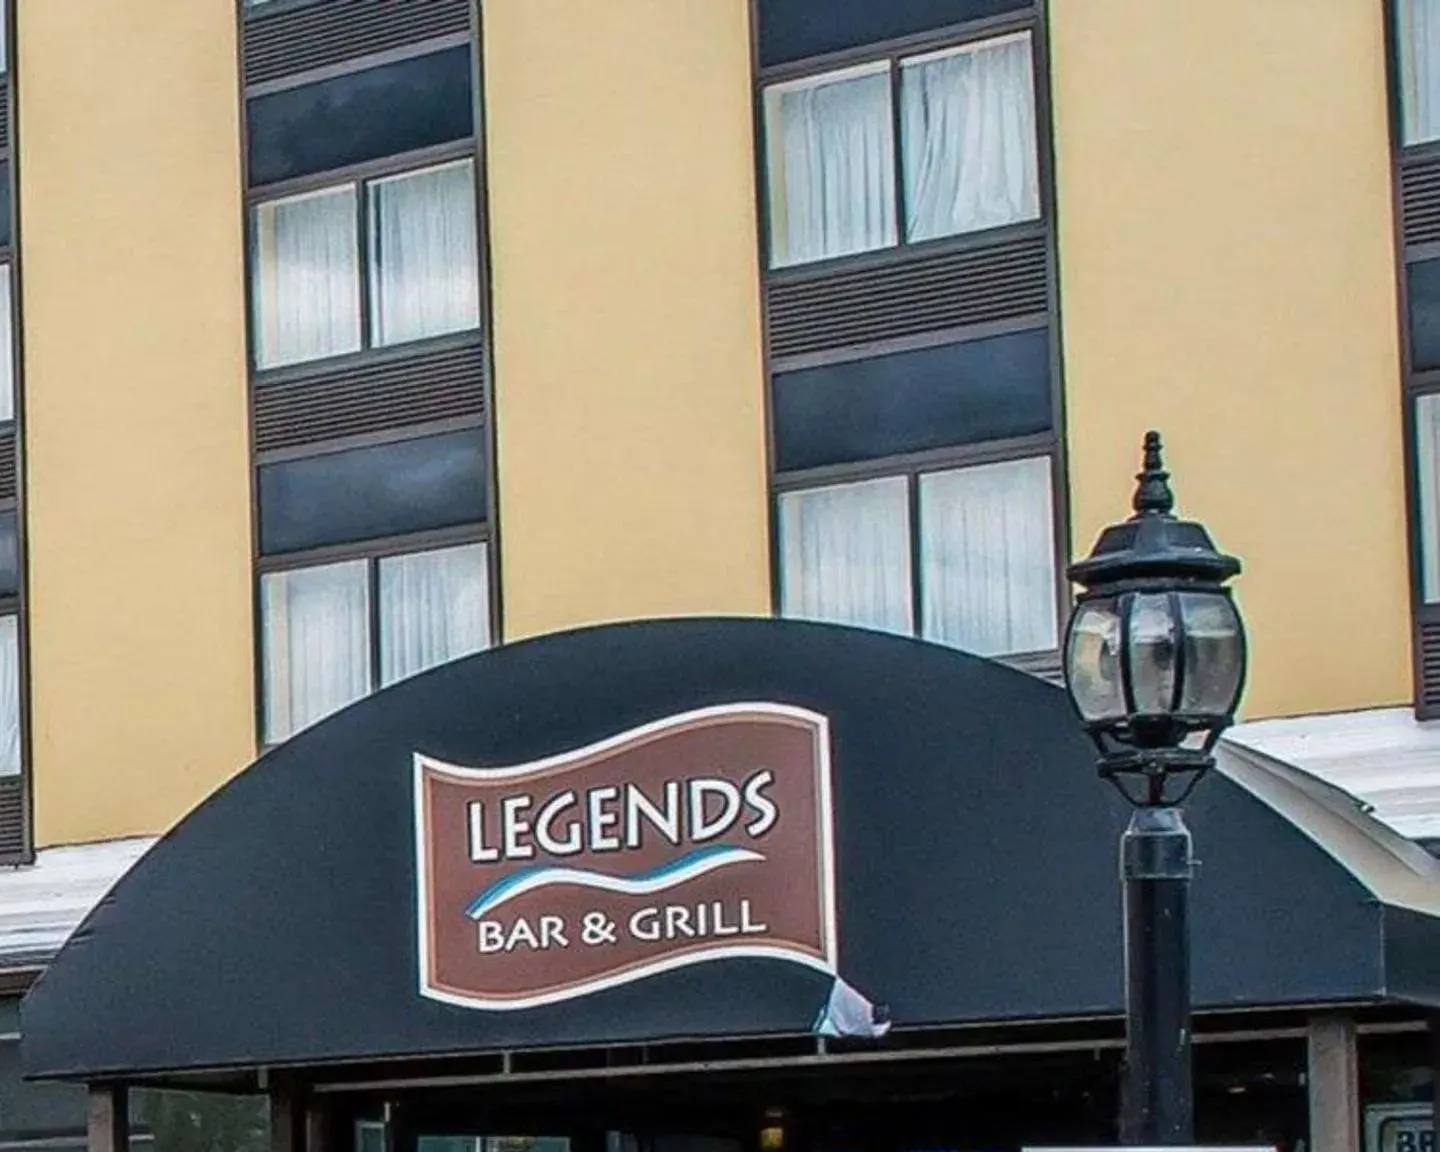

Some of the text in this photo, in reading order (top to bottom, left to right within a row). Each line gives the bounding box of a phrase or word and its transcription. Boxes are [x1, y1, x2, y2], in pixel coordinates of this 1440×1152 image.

[469, 769, 777, 863] LEGENDS
[478, 899, 767, 953] BAR & GRILL
